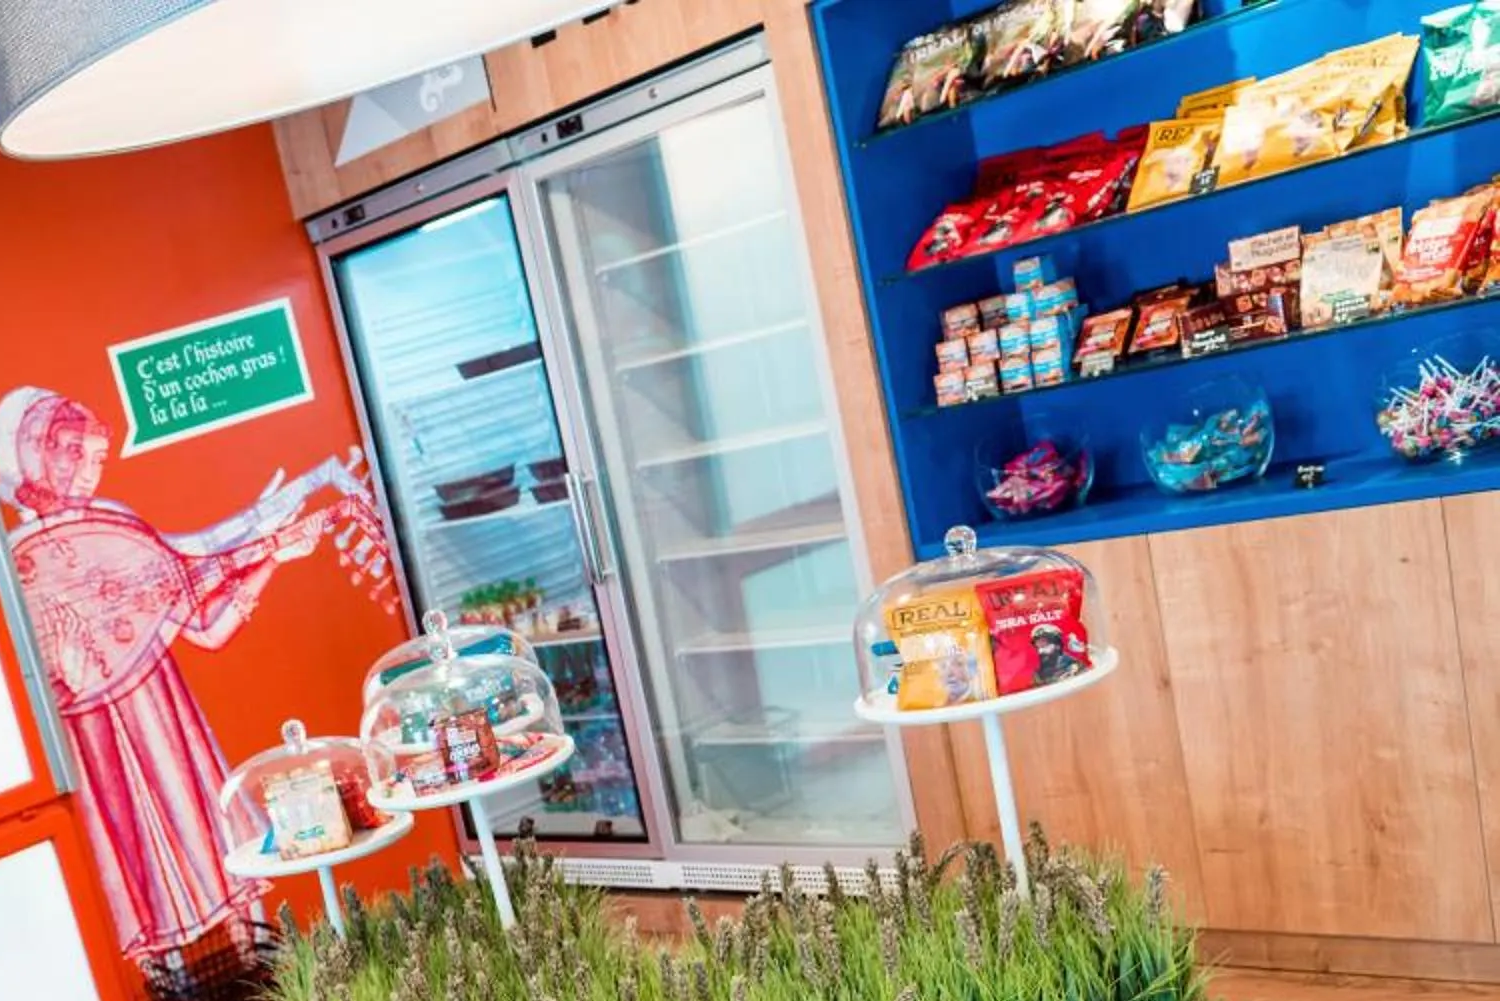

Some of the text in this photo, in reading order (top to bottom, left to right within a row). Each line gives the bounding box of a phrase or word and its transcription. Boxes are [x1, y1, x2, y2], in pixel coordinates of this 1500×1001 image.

[136, 352, 181, 379] C'est
[184, 361, 238, 390] cochon
[241, 352, 277, 379] gras
[150, 403, 169, 426] la
[170, 397, 189, 419] la
[190, 391, 209, 414] la
[901, 602, 966, 626] REAL
